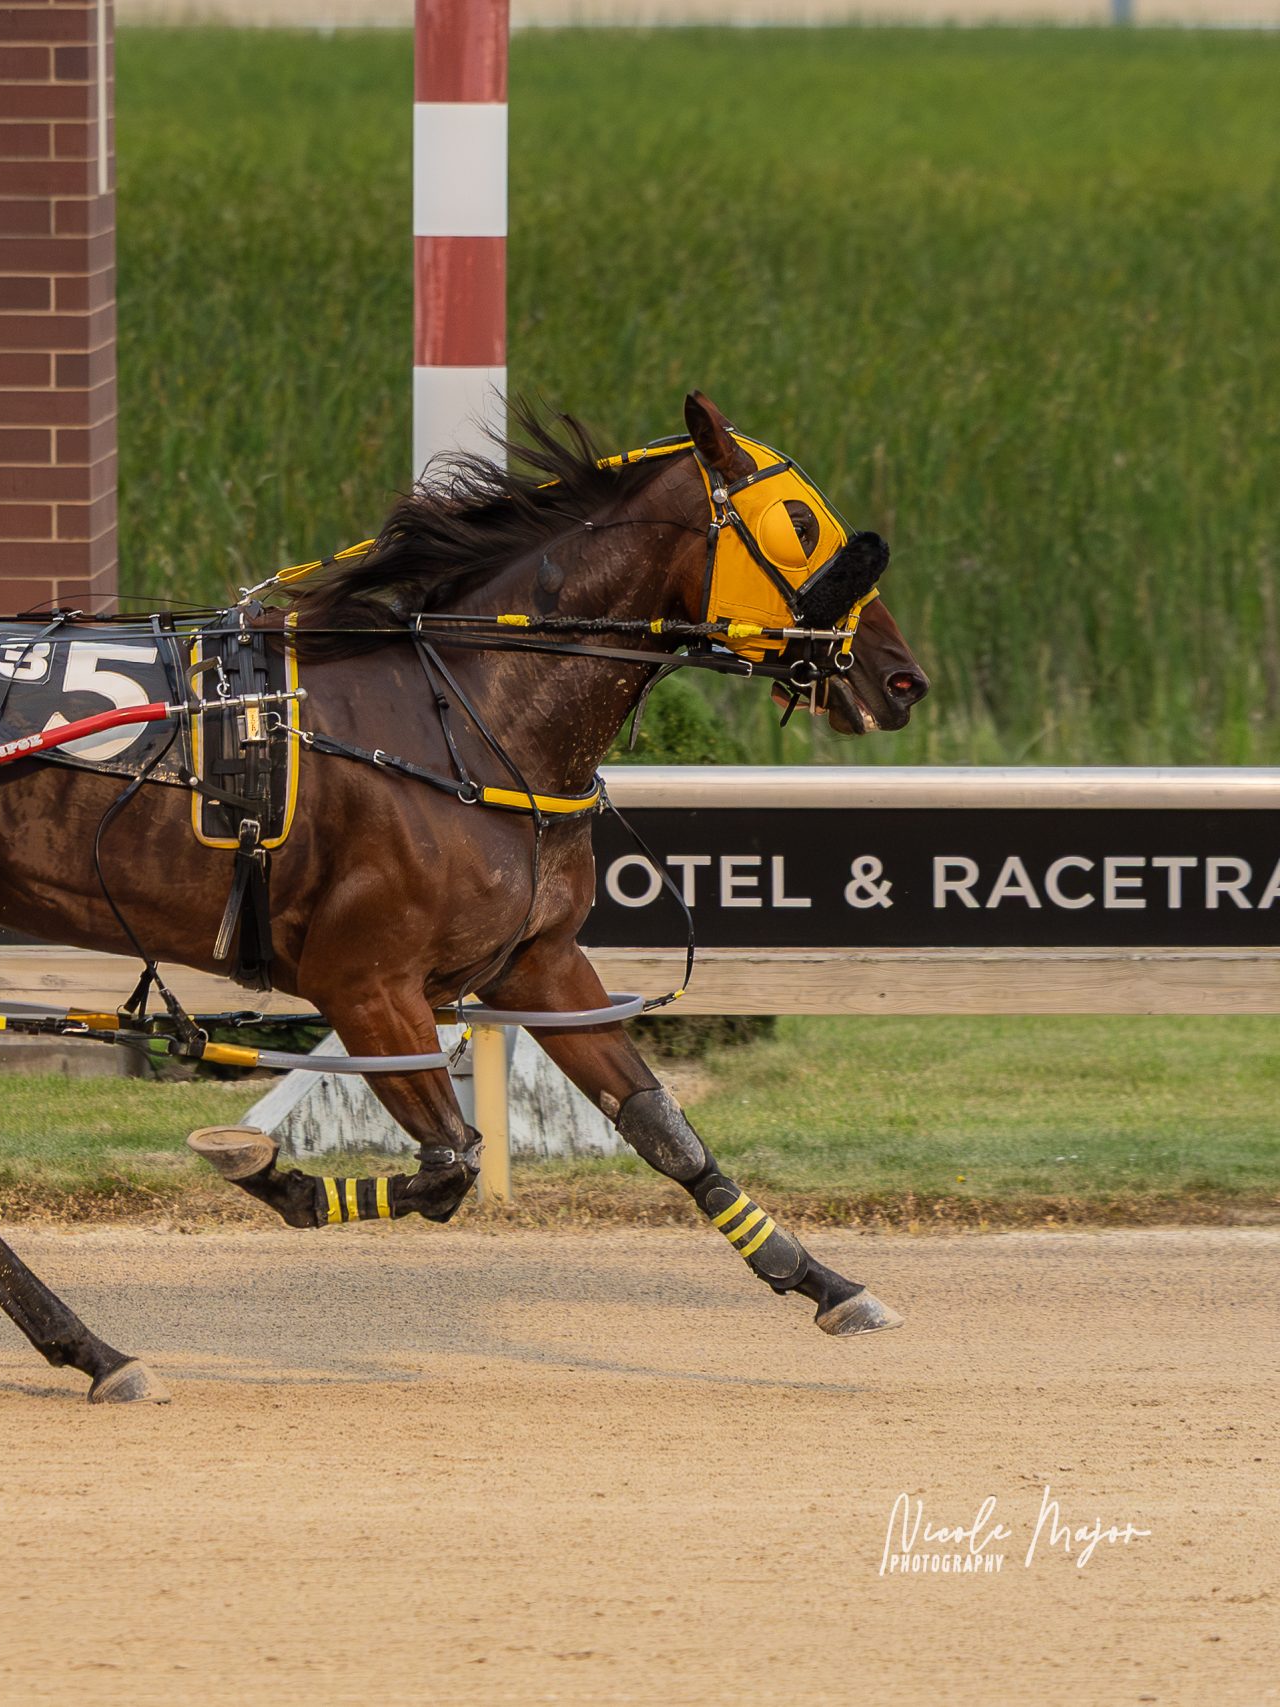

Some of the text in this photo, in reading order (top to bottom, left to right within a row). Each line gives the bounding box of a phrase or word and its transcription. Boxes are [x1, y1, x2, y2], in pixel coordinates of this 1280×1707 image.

[41, 640, 159, 761] 5
[592, 854, 812, 908] OTEL
[844, 855, 894, 909] &
